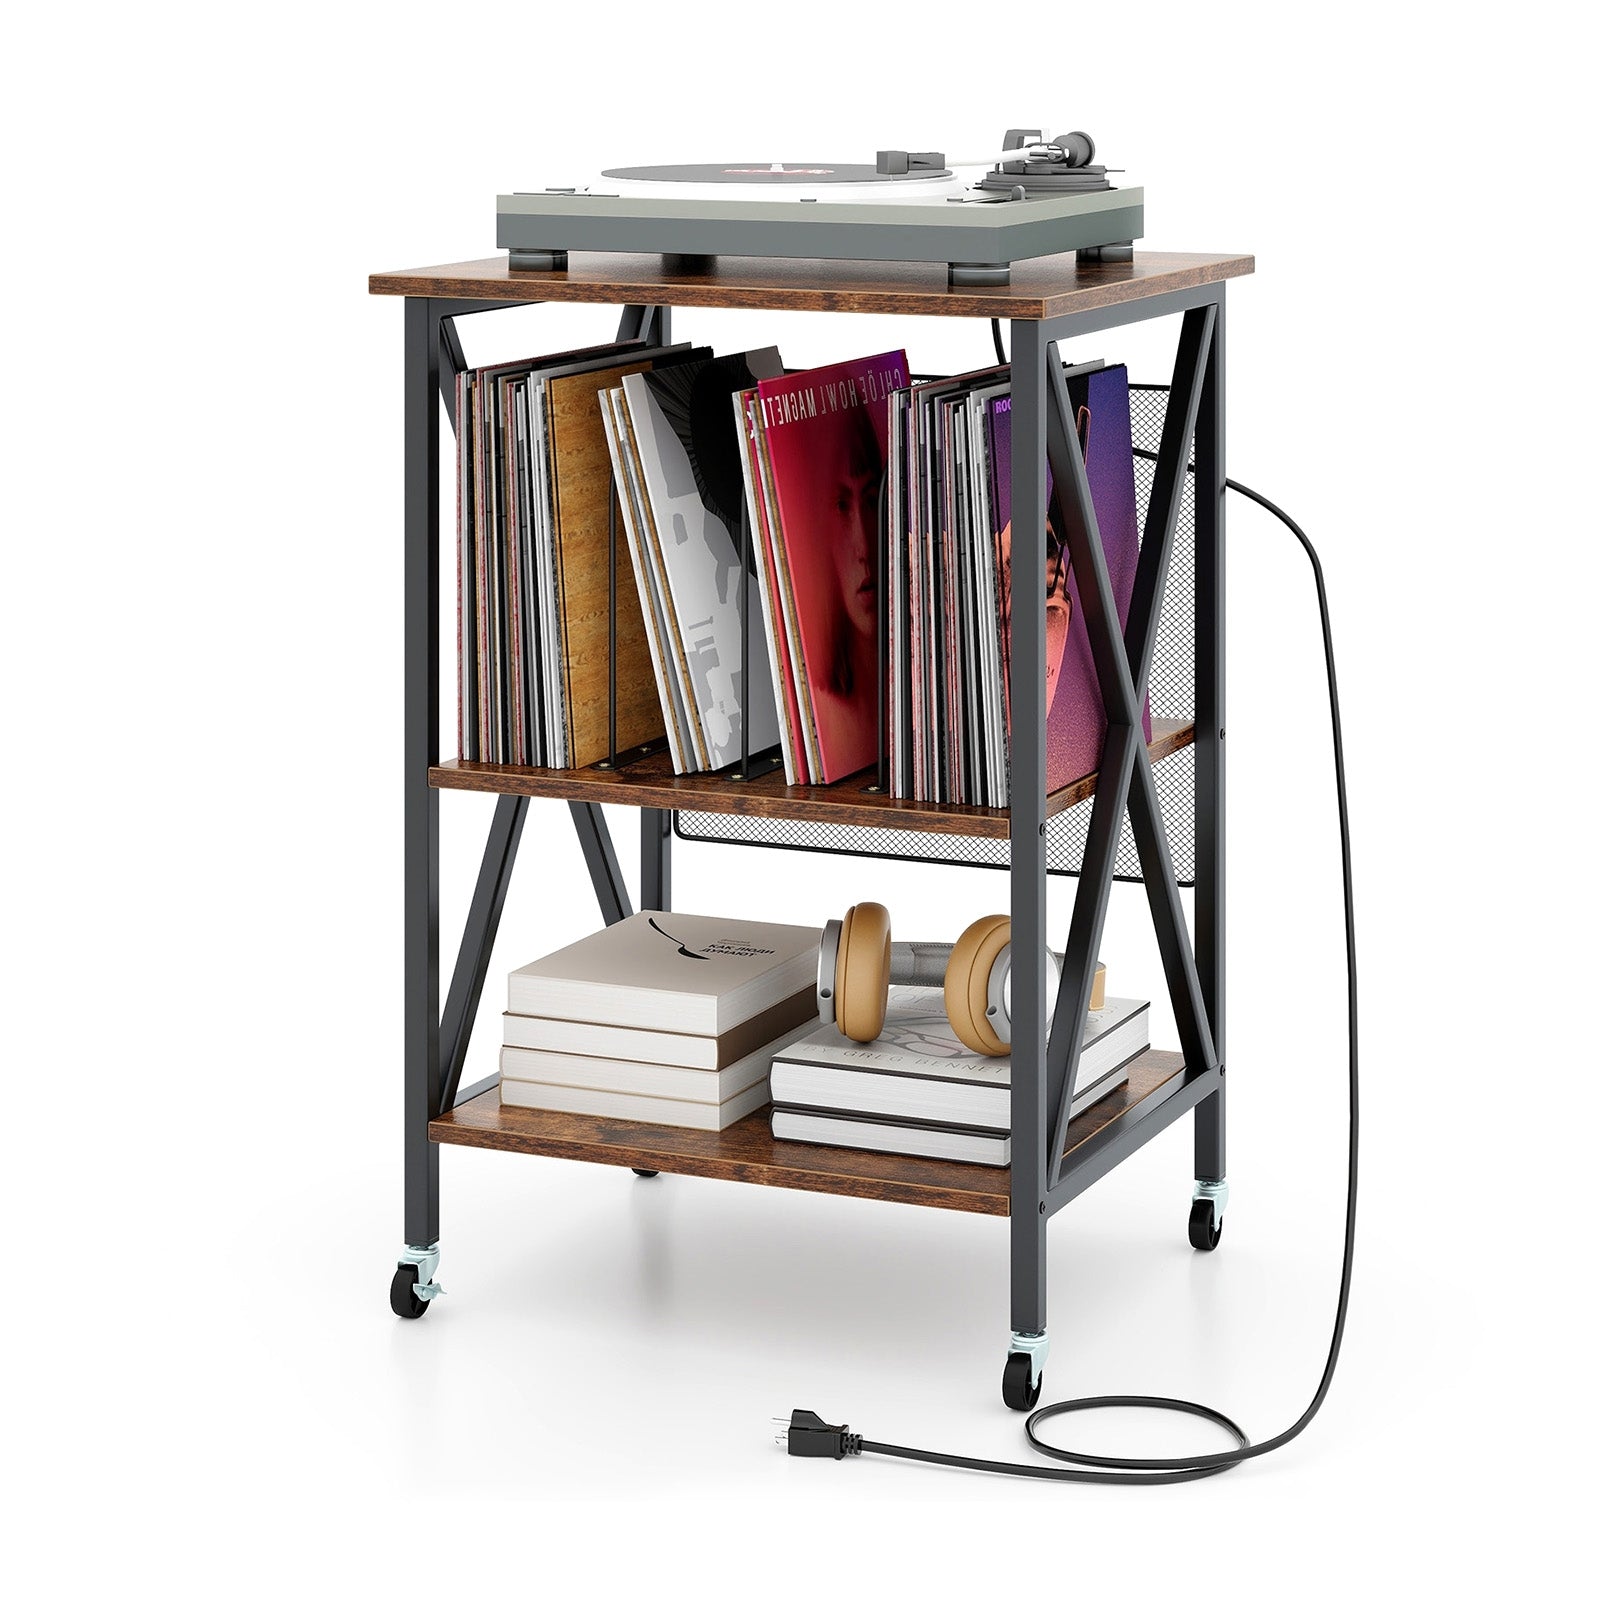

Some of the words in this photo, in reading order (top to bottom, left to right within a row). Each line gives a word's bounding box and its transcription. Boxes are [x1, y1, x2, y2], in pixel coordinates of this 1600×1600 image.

[699, 948, 758, 957] ДУМАЮТ
[803, 1045, 833, 1053] BY
[843, 1051, 904, 1062] GREG
